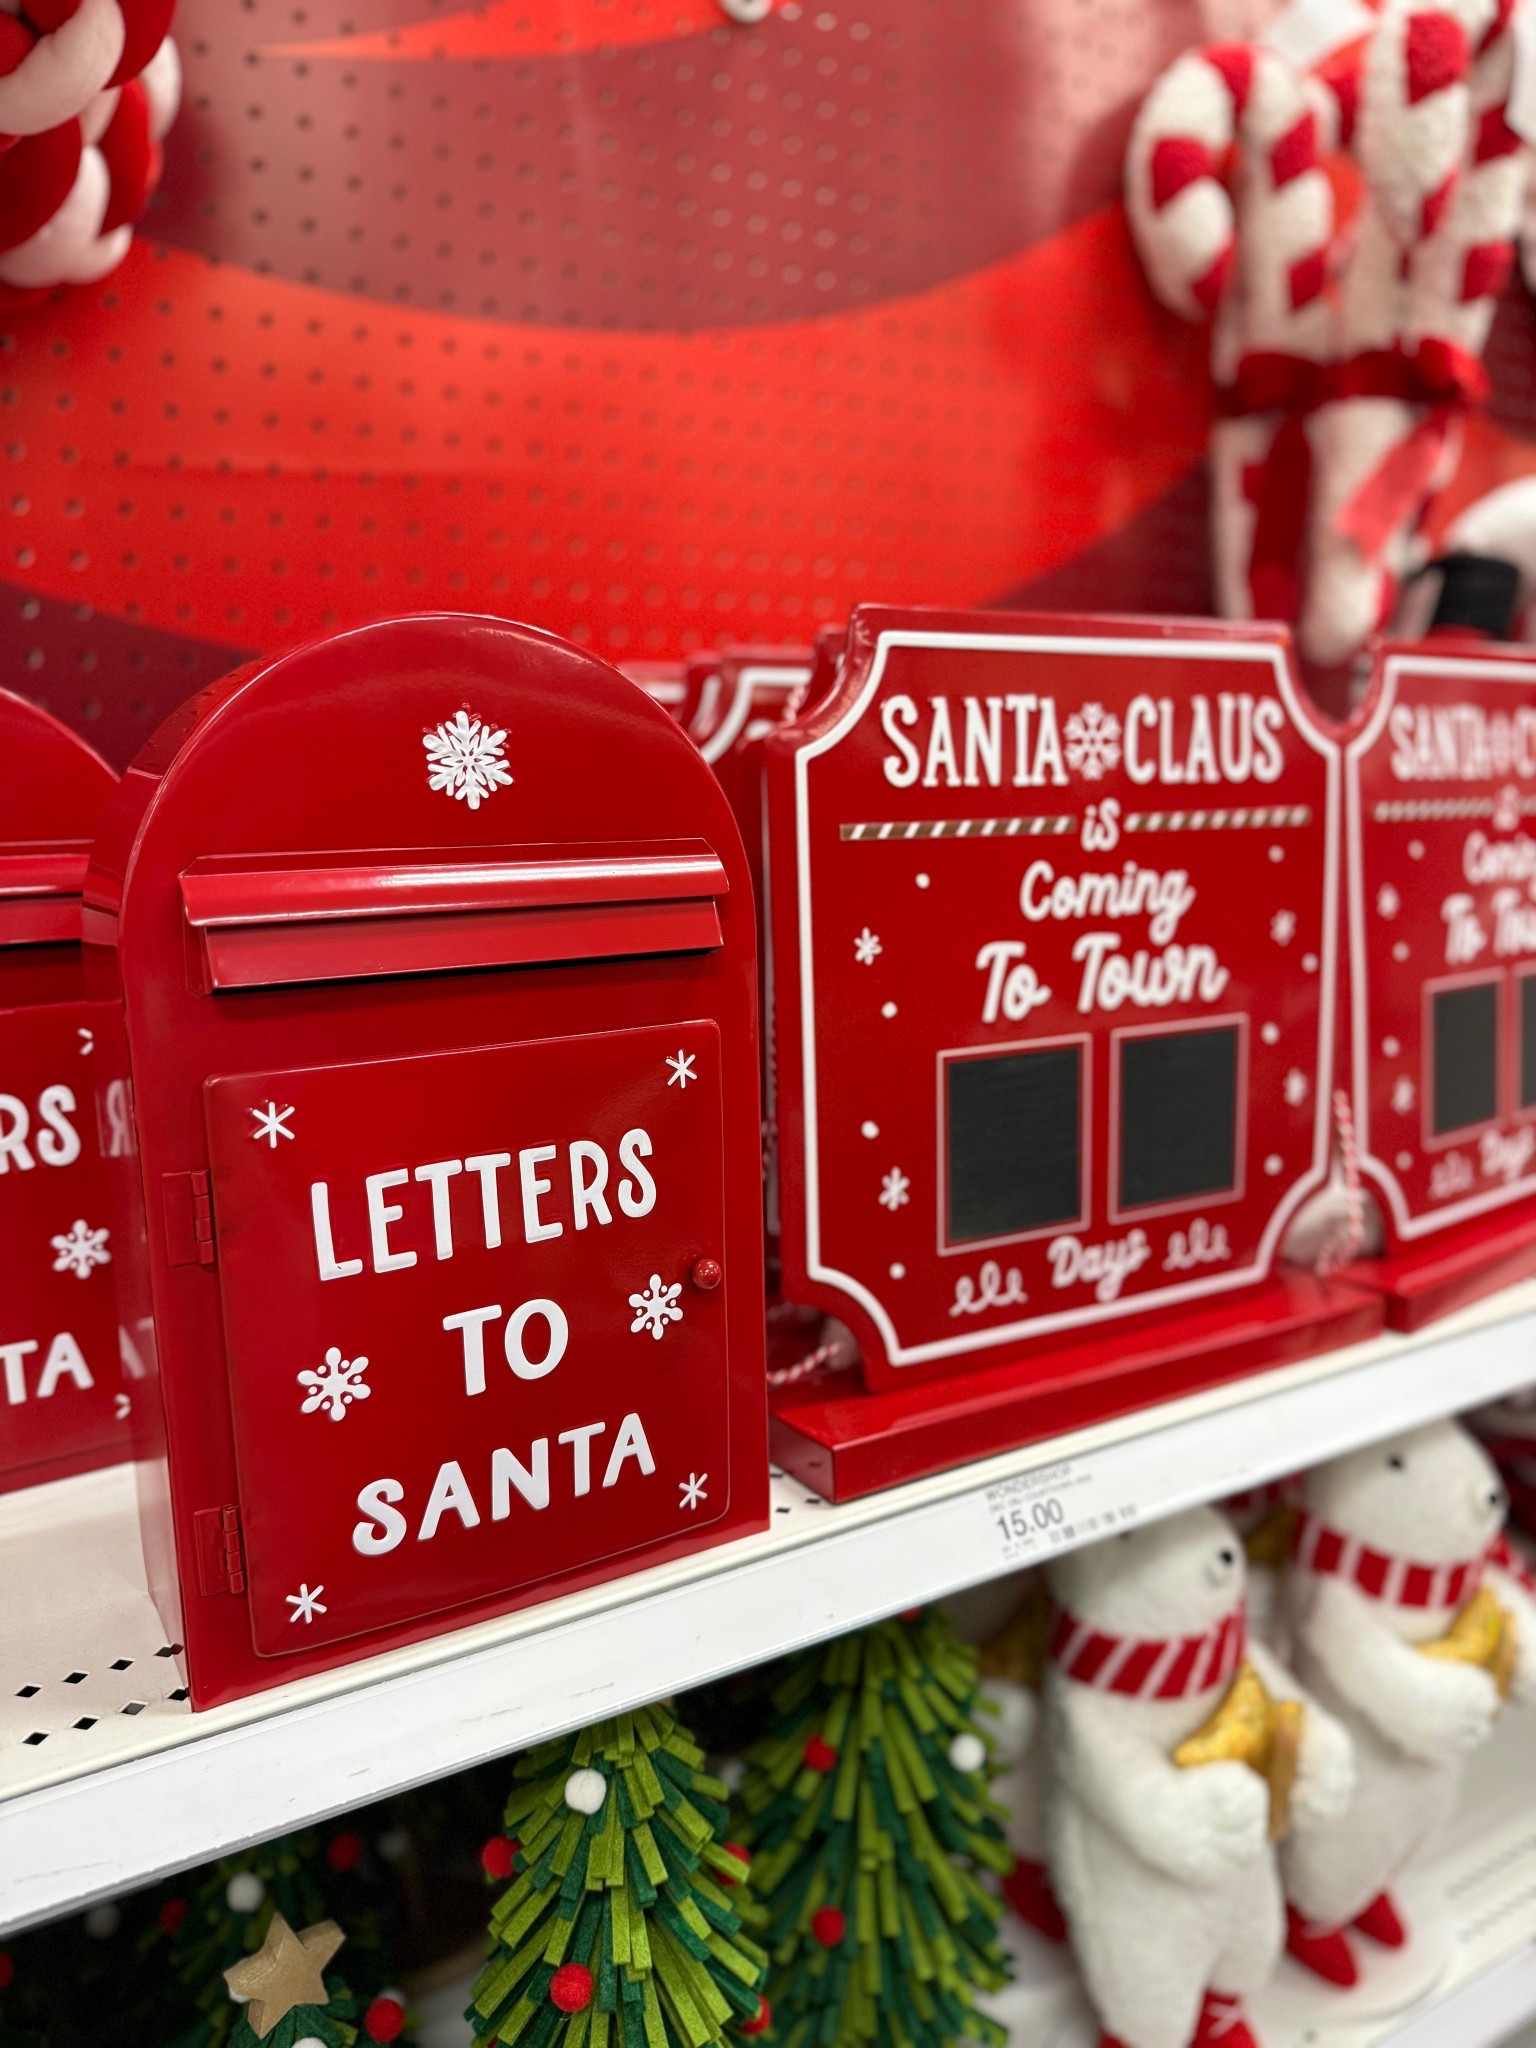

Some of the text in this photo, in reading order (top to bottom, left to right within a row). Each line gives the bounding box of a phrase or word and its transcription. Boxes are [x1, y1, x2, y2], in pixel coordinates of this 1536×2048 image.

[879, 692, 1285, 788] SANTA CLAUS
[1020, 861, 1196, 945] Coming
[976, 931, 1230, 1024] To Town
[311, 1128, 657, 1282] LETTERS
[1047, 1230, 1151, 1304] Days
[442, 1298, 569, 1397] TO
[352, 1412, 656, 1556] SANTA
[997, 1498, 1064, 1541] 15.00
